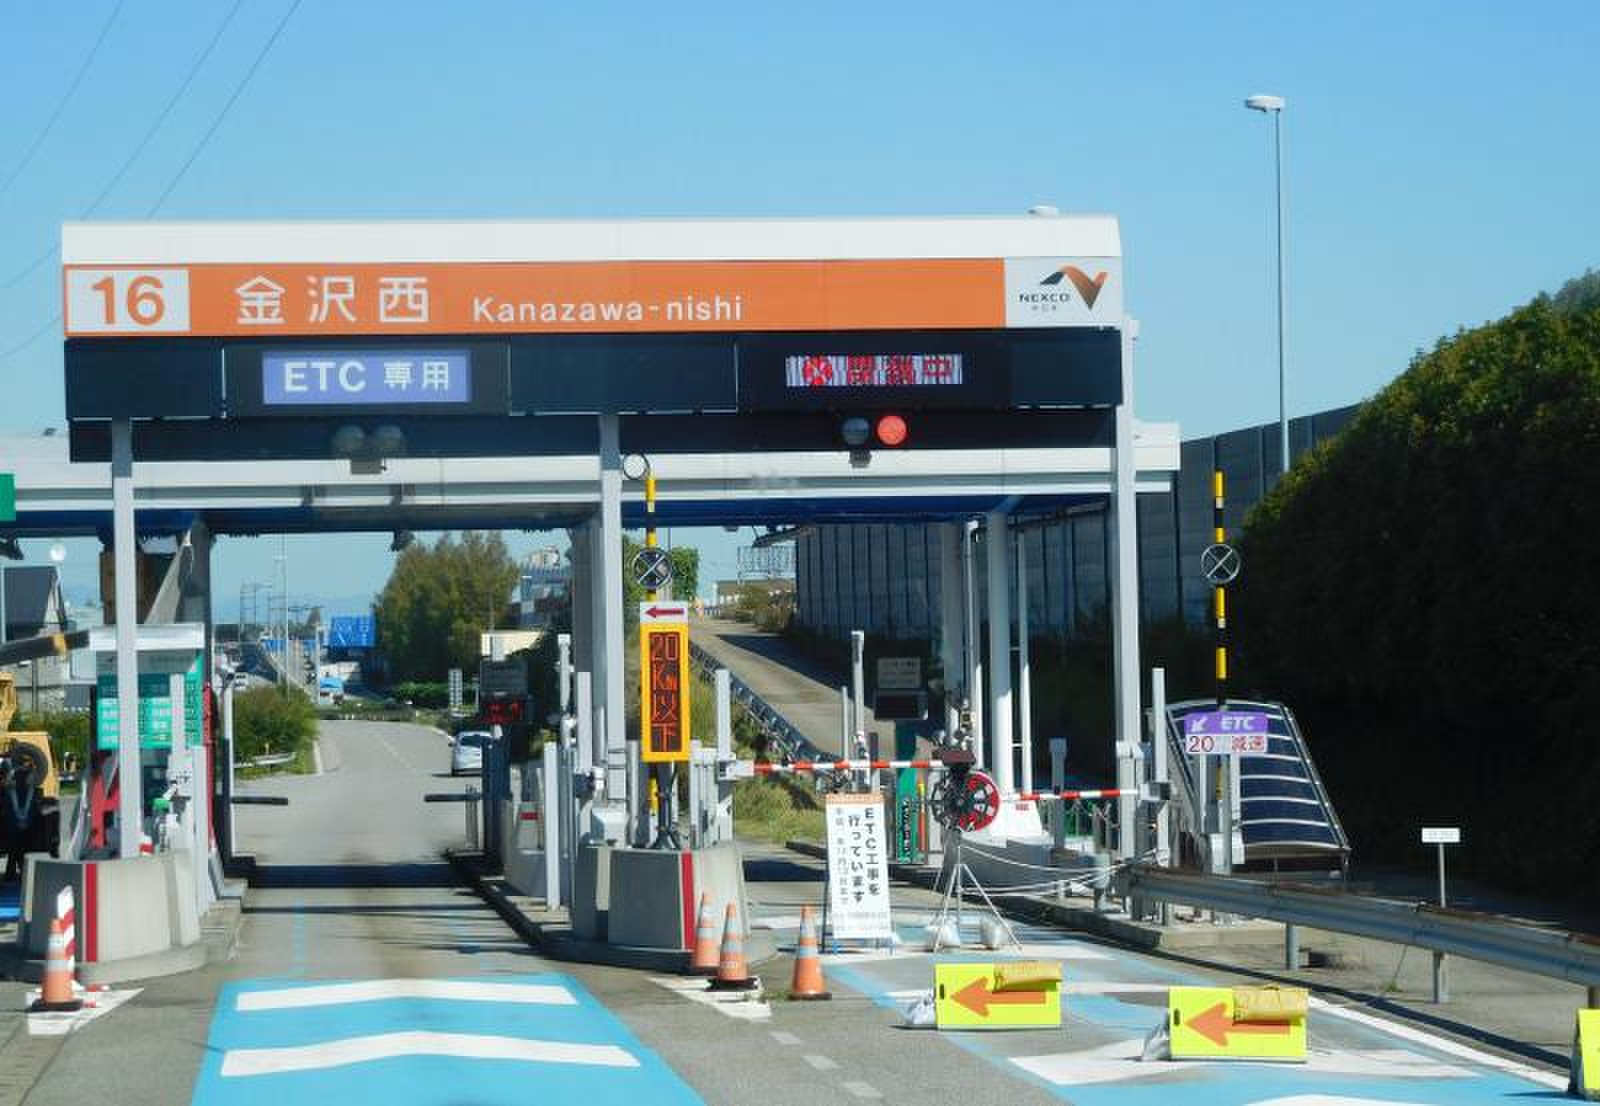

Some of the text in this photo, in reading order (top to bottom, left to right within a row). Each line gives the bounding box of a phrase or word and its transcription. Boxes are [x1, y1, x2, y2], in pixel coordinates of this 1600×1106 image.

[92, 276, 165, 325] 16
[236, 275, 429, 325] 金沢西
[473, 294, 742, 322] Kanazawa-nishi
[1019, 293, 1070, 303] NEXCO
[283, 361, 450, 392] ETC 専用
[1221, 714, 1255, 730] ETC
[1188, 735, 1215, 753] 20
